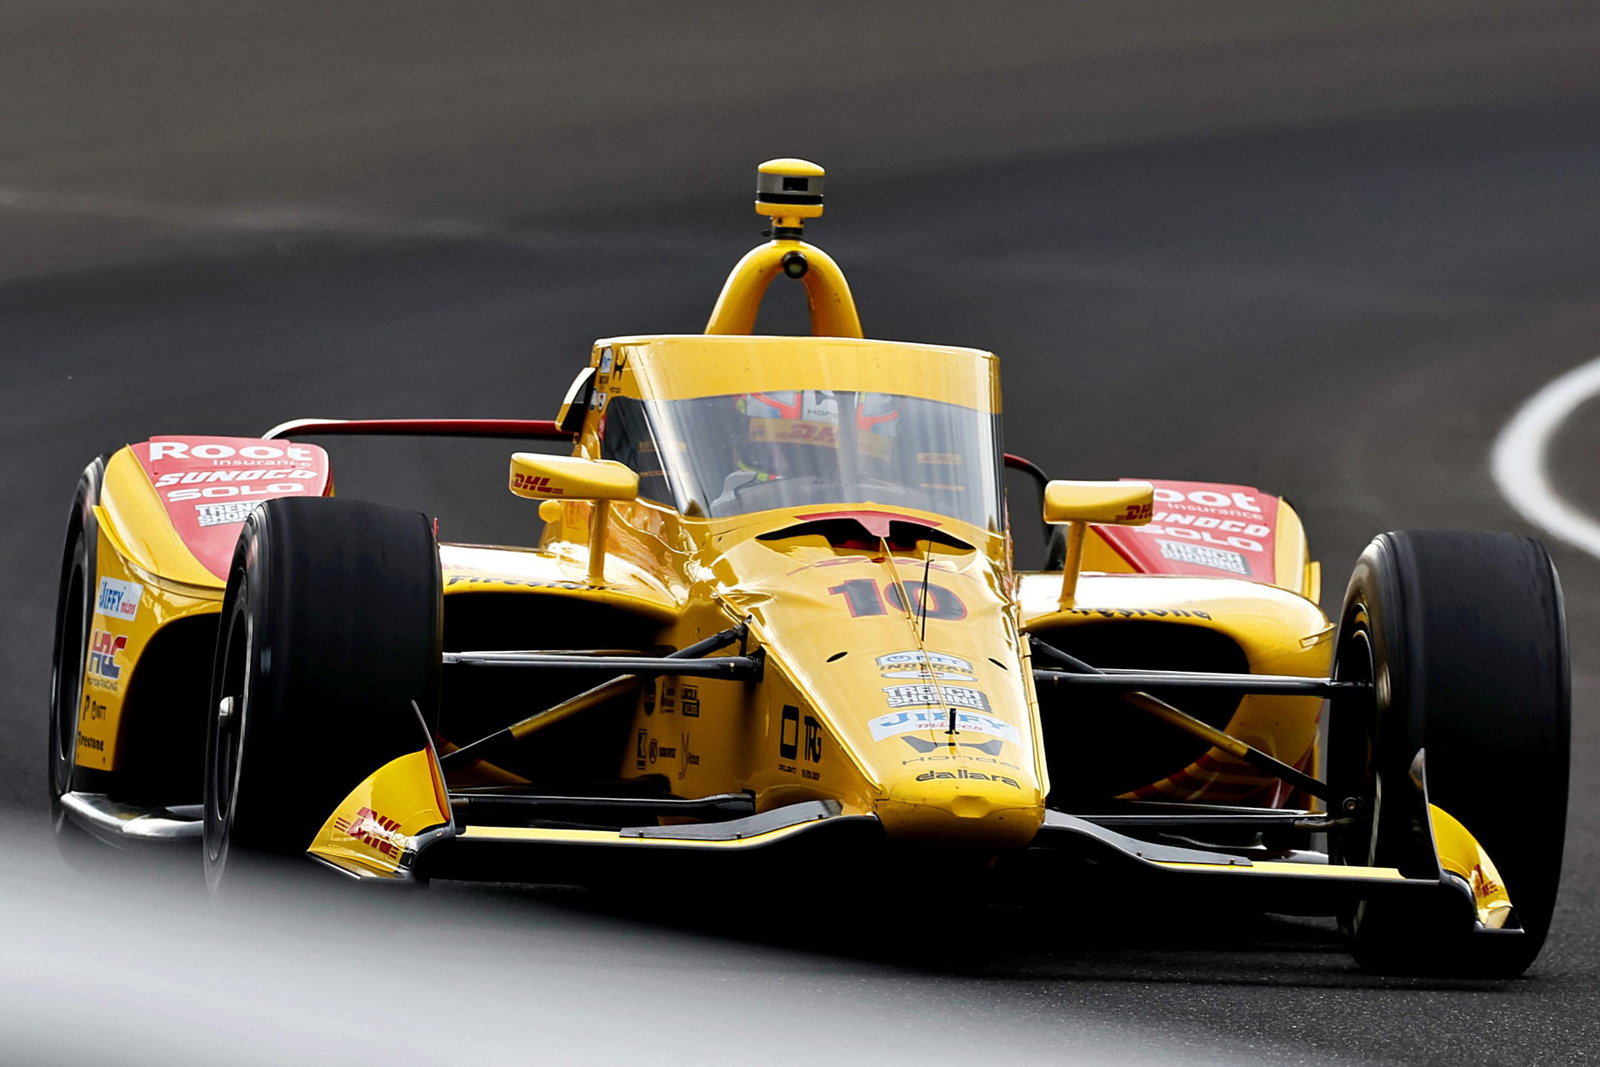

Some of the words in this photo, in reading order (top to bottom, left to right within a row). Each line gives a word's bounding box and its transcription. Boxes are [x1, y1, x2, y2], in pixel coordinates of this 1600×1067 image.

[155, 469, 319, 488] SUNOCO
[514, 472, 553, 493] DHL
[167, 483, 304, 502] SOLO
[1152, 487, 1262, 512] oot
[195, 502, 260, 516] TREN
[1151, 511, 1271, 538] UNOCO
[99, 580, 125, 612] JIFFY
[827, 578, 968, 621] 10
[89, 631, 128, 679] HRC
[884, 685, 981, 701] TRENCH
[888, 693, 985, 708] SHORING
[880, 711, 1010, 730] JIFFY
[915, 768, 1022, 790] dallara
